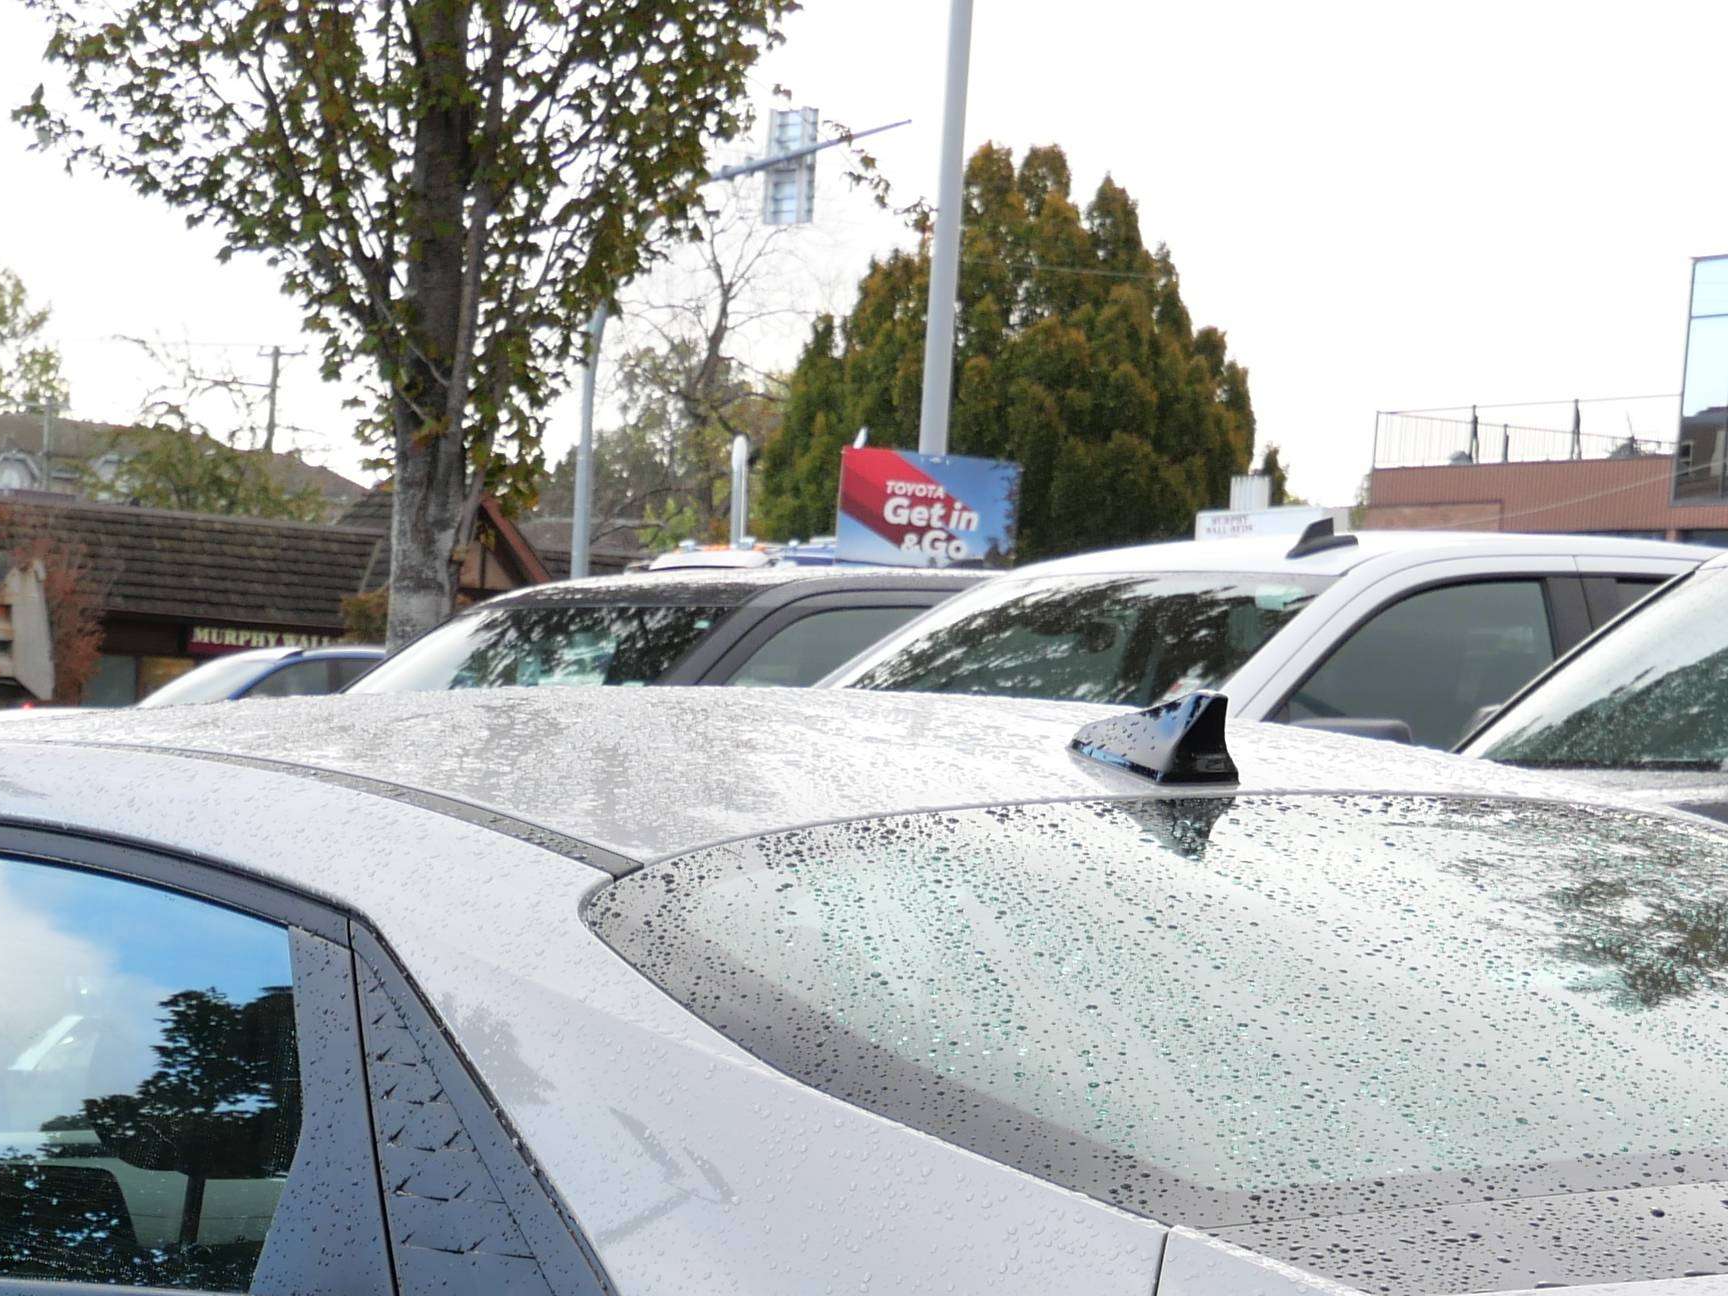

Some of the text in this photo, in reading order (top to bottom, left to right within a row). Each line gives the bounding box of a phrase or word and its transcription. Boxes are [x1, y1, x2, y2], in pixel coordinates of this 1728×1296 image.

[886, 480, 945, 499] TOYOTA
[883, 497, 979, 532] Get in
[192, 626, 278, 648] MURPHY
